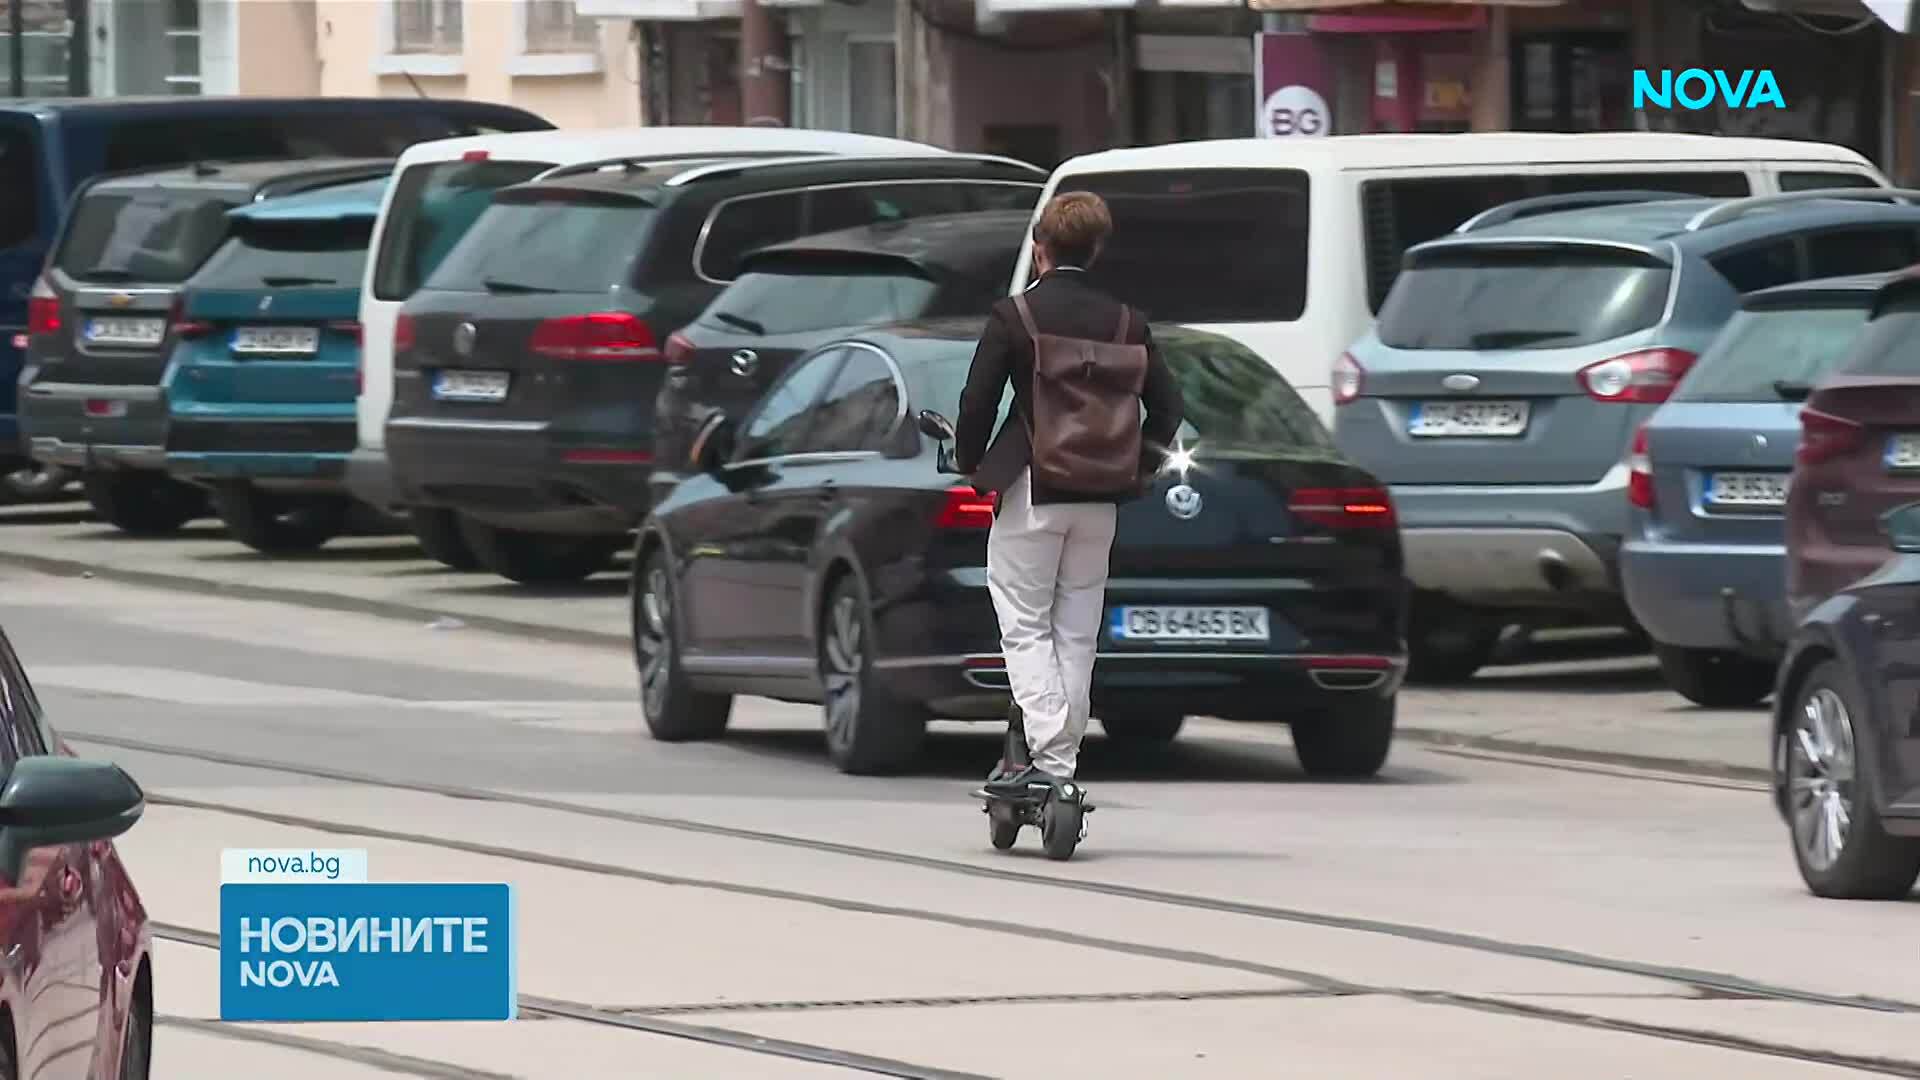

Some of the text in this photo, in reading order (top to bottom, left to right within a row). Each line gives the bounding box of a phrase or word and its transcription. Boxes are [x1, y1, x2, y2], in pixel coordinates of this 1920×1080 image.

[1271, 108, 1321, 136] BG
[1130, 609, 1263, 635] CB 6465 BK
